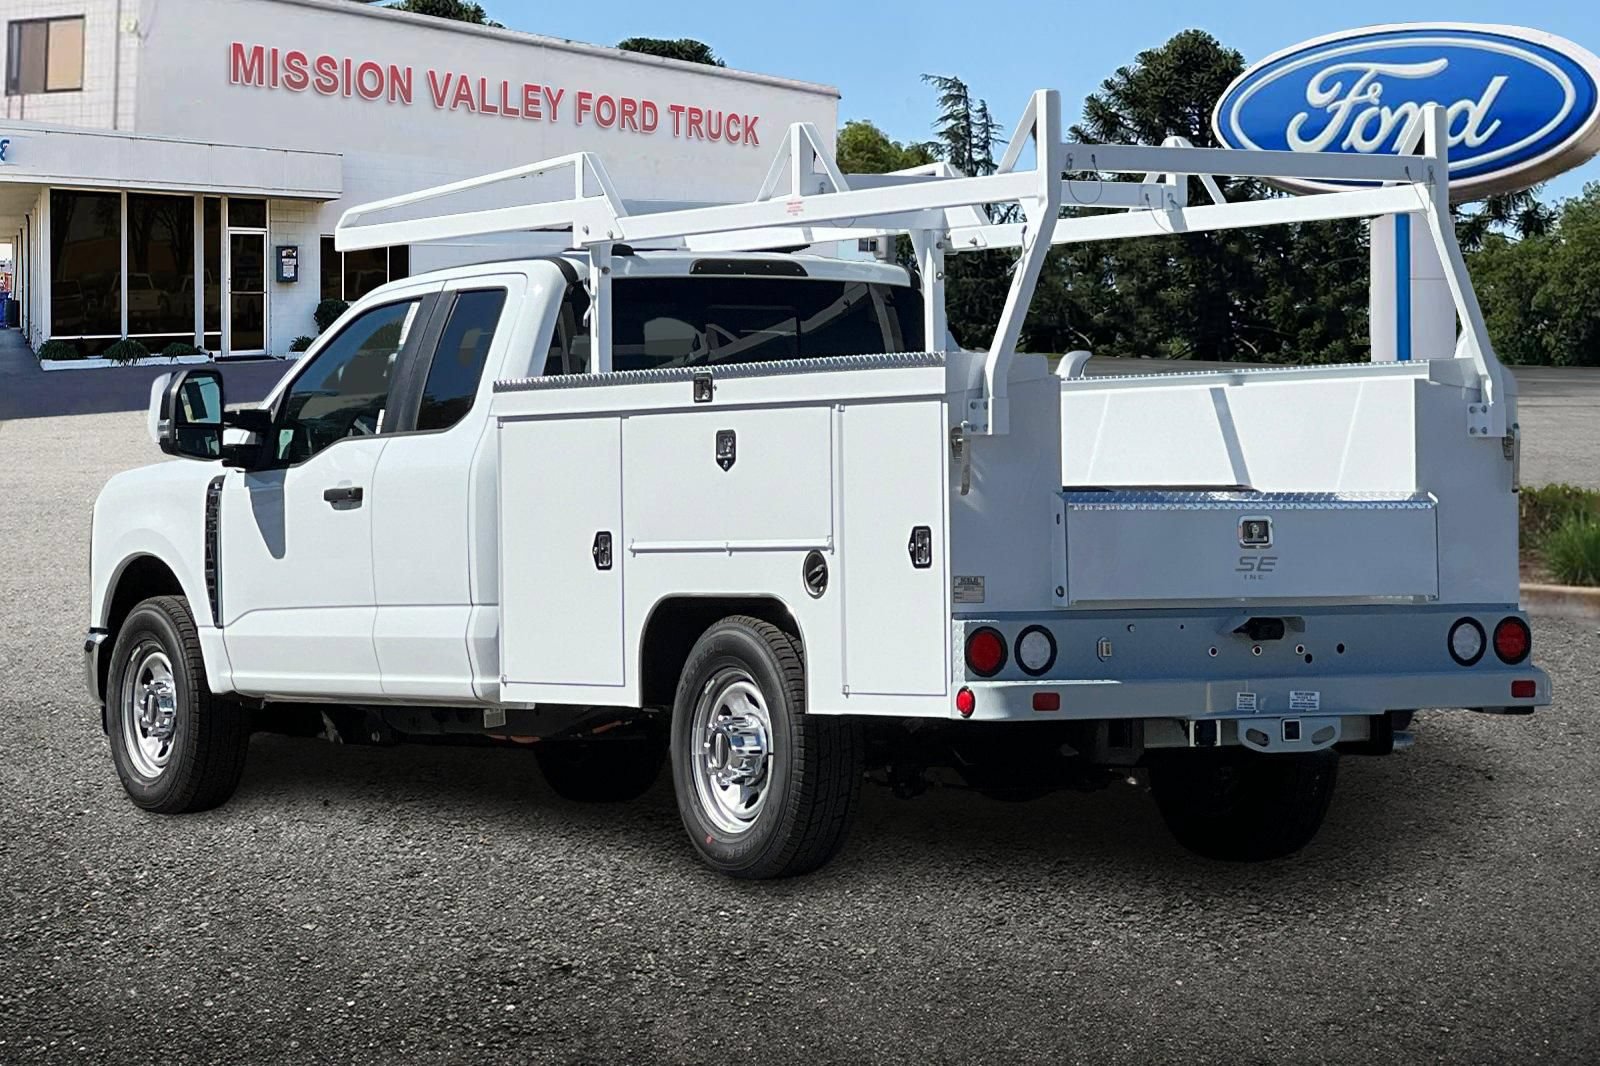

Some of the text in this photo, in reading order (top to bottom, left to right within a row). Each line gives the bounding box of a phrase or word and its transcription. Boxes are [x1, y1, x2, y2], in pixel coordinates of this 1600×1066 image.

[231, 41, 760, 146] MISSION VALLEY FORD TRUCK
[1286, 57, 1509, 154] Ford
[1235, 556, 1278, 572] SE
